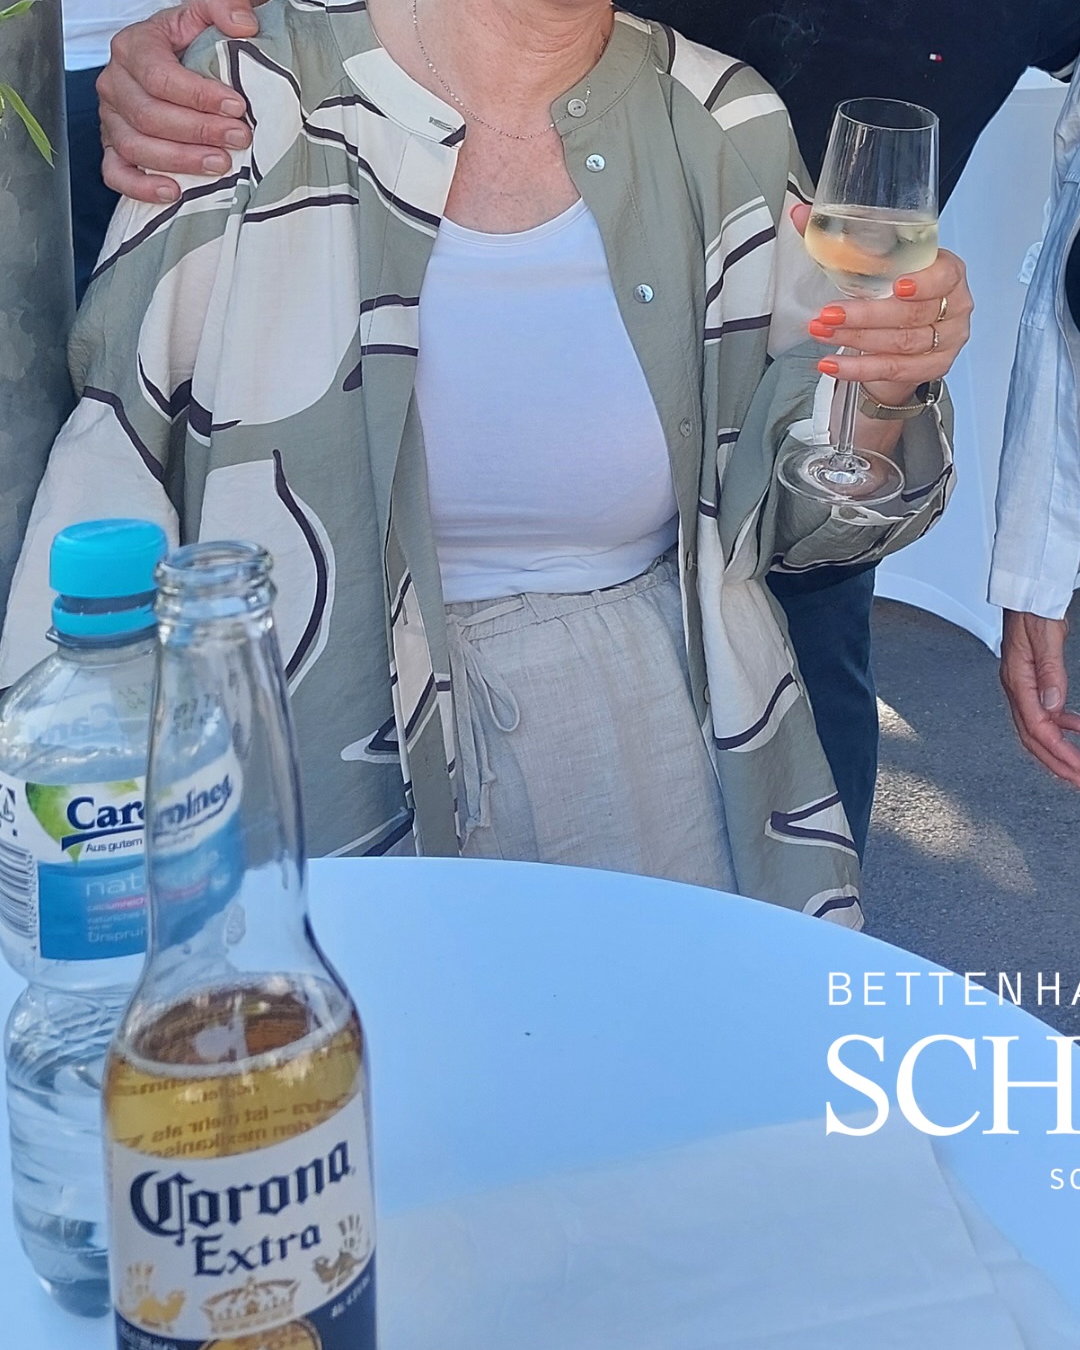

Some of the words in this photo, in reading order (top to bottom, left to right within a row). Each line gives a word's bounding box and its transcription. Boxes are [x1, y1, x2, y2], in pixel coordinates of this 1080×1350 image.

[86, 843, 107, 853] Aus
[108, 838, 143, 853] gutem
[129, 1140, 352, 1246] Corona
[192, 1224, 322, 1277] Extra
